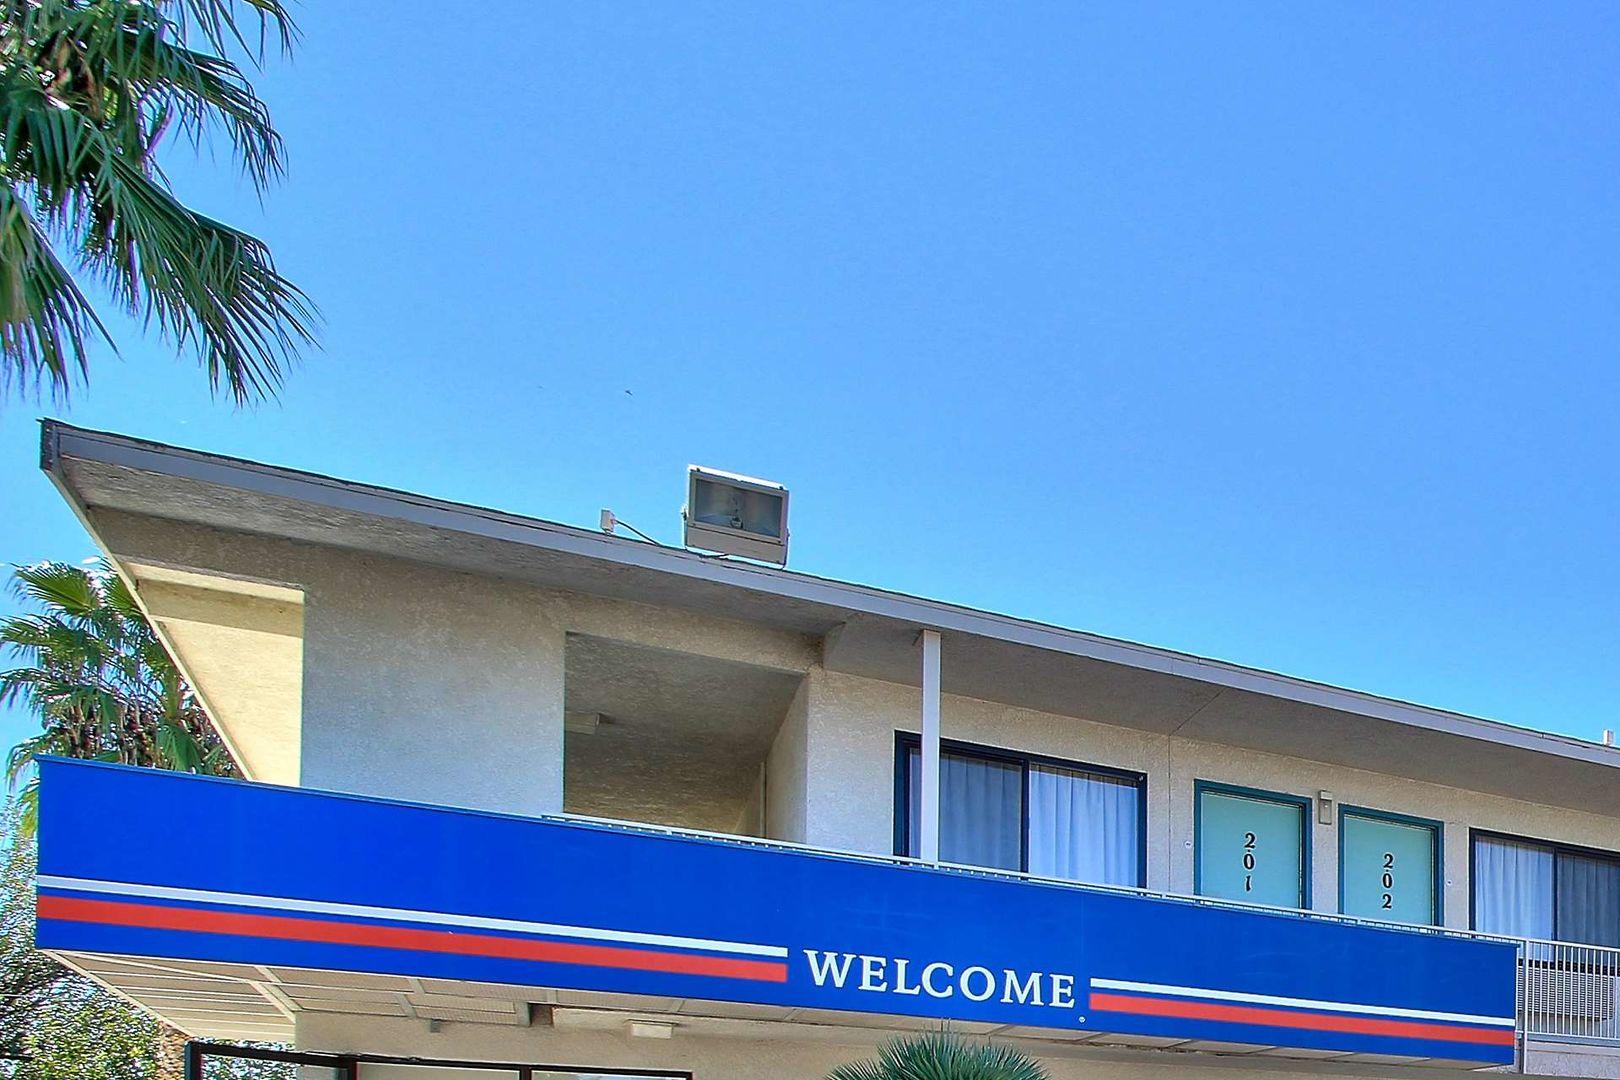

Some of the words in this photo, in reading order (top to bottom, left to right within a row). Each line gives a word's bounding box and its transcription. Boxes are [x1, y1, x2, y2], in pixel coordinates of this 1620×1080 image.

[1243, 832, 1256, 892] 201
[1381, 853, 1394, 909] 202
[803, 949, 1076, 1009] WELCOME
